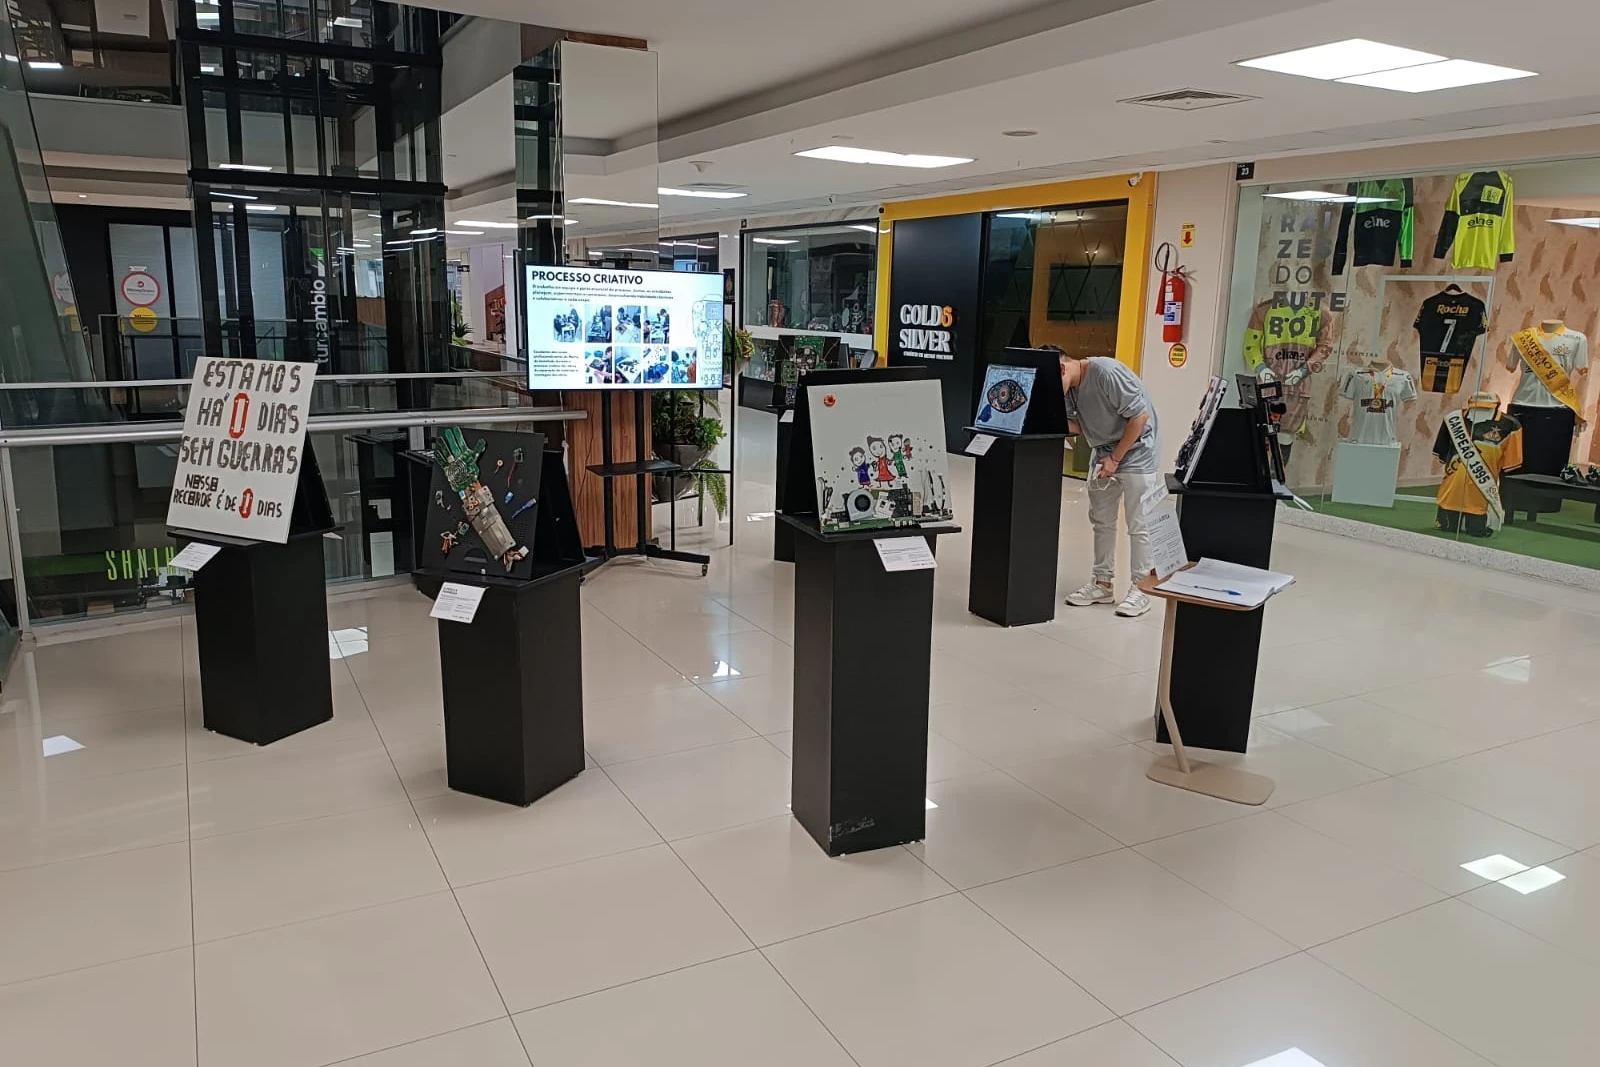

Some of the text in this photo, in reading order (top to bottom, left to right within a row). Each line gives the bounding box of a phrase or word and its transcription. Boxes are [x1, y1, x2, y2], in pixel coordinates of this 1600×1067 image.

[1277, 239, 1332, 259] ZES
[532, 270, 643, 285] PROCESSO CRIATIVO
[1275, 265, 1312, 285] DO
[1437, 304, 1470, 314] Rocha
[899, 328, 951, 353] SILVER
[1440, 319, 1457, 353] 7
[203, 361, 301, 393] ESTAMOS
[196, 393, 230, 427] HÁ
[257, 402, 299, 434] DIAS
[180, 436, 298, 475] SEM GUERRAS
[185, 473, 219, 492] NOSSO
[1469, 460, 1491, 485] 1995
[172, 488, 212, 508] RECORDE
[216, 488, 225, 510] É
[224, 495, 238, 512] DE
[257, 499, 283, 518] DIAS
